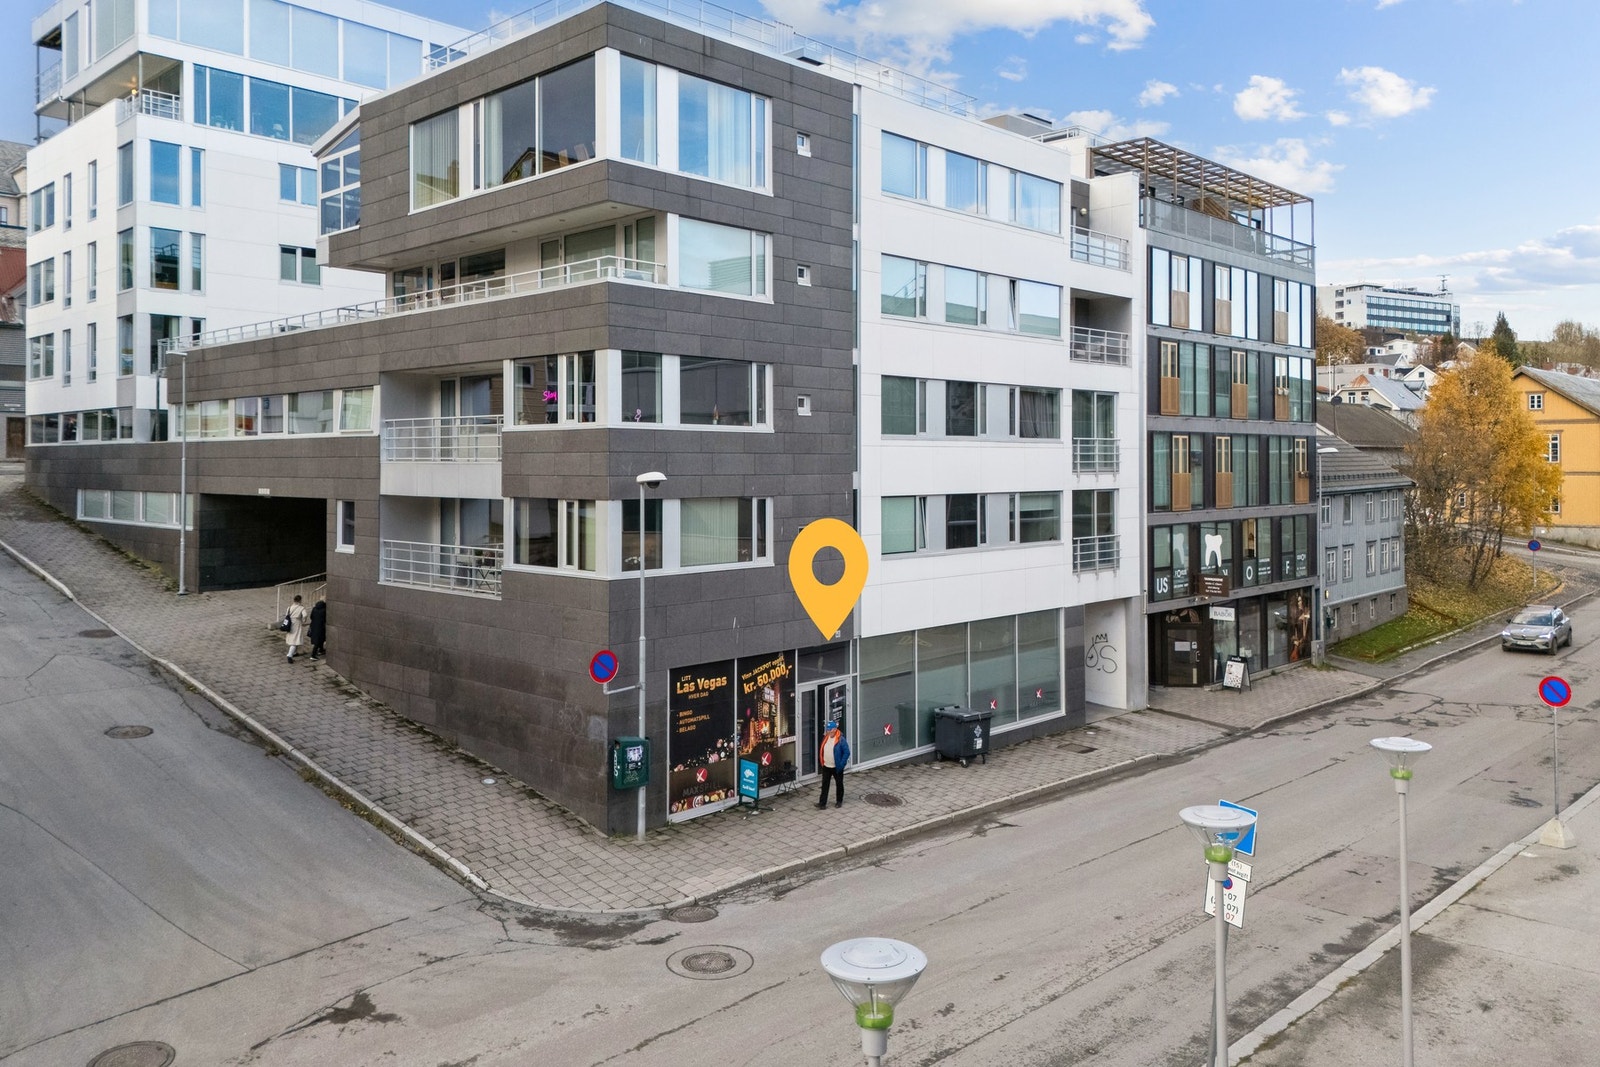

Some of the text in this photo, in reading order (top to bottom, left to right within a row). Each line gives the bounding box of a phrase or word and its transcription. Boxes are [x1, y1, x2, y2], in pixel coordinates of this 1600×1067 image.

[1156, 577, 1168, 593] US
[752, 661, 772, 675] JACKPOT
[676, 676, 727, 694] Las Vegas
[679, 709, 693, 717] BINGO
[682, 780, 721, 796] MAXSPILL
